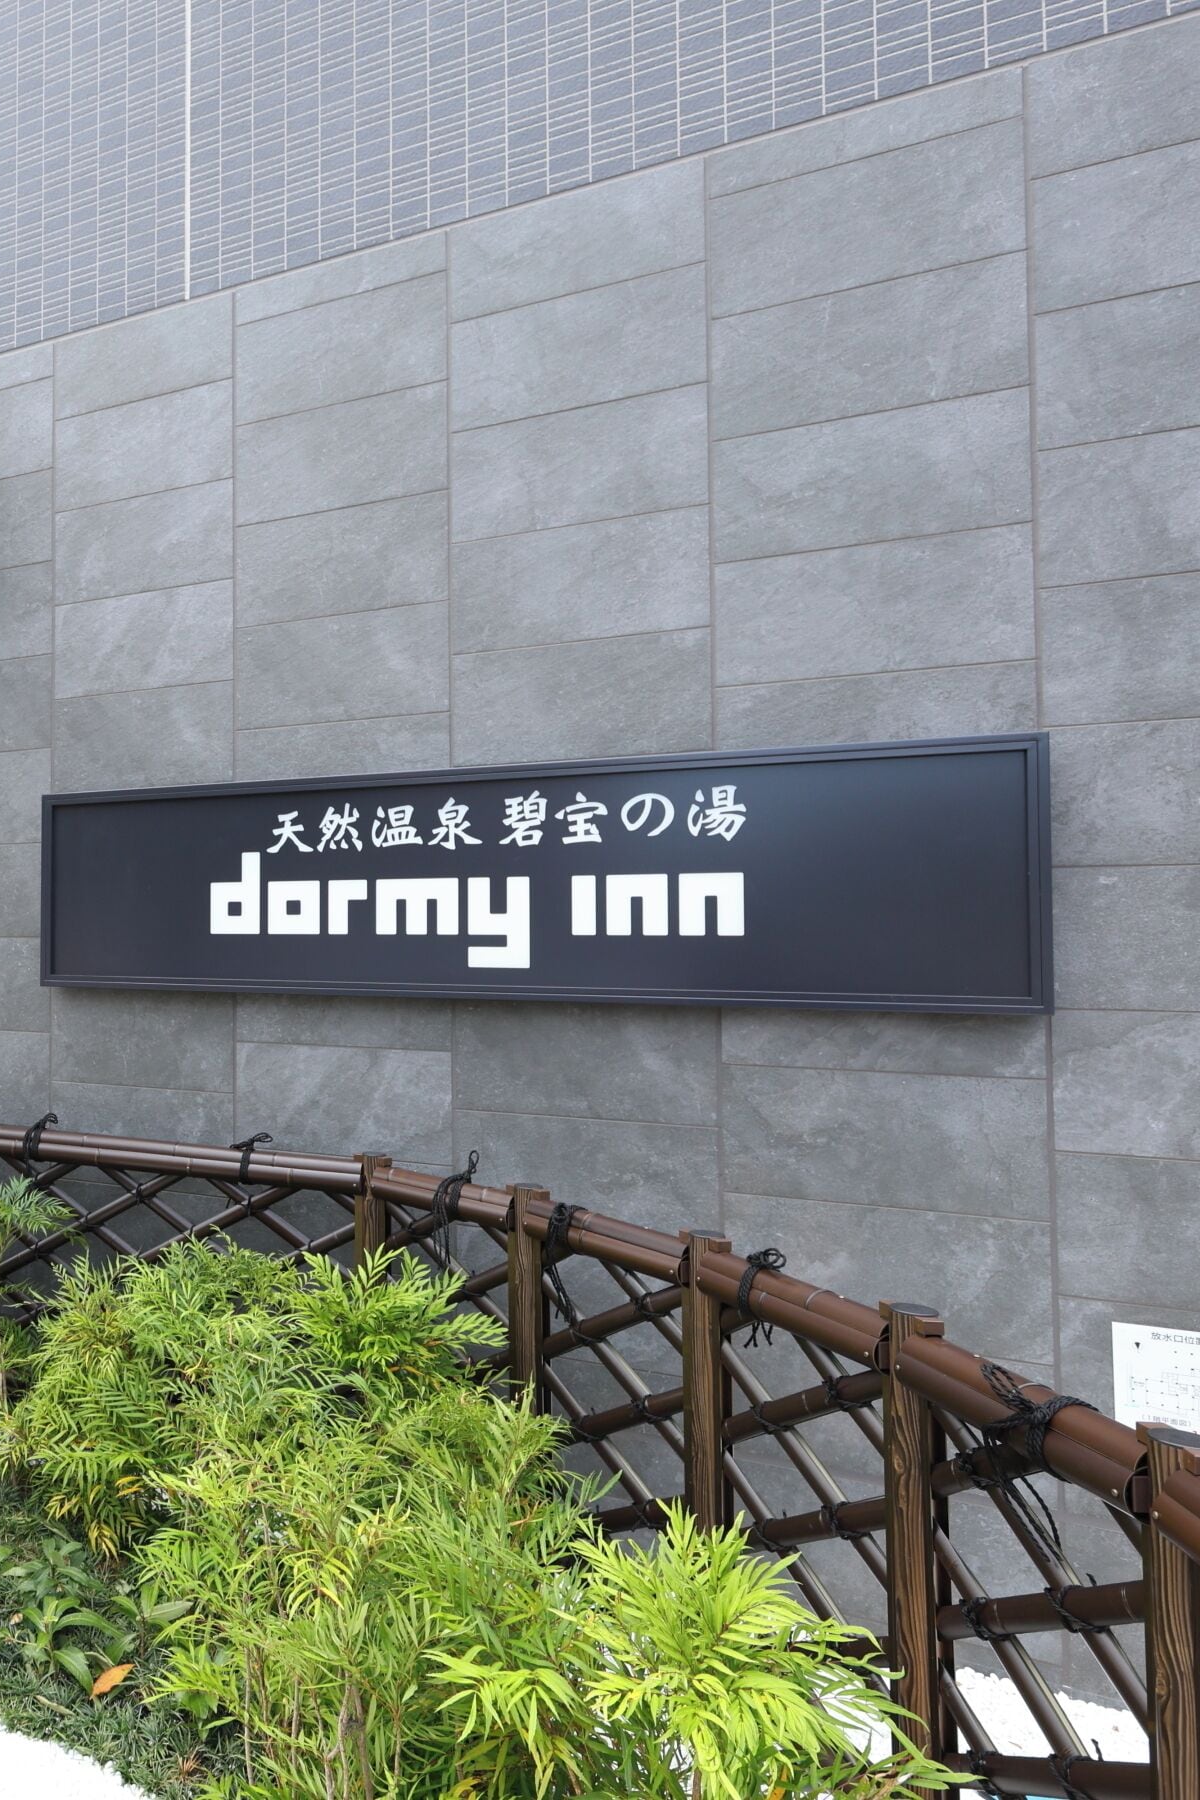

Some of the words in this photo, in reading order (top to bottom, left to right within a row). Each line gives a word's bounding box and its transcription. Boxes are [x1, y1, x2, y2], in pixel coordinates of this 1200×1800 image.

[266, 796, 483, 854] 天然温泉
[498, 785, 747, 847] 碧宝の湯
[210, 851, 530, 968] dormy
[571, 872, 745, 936] inn
